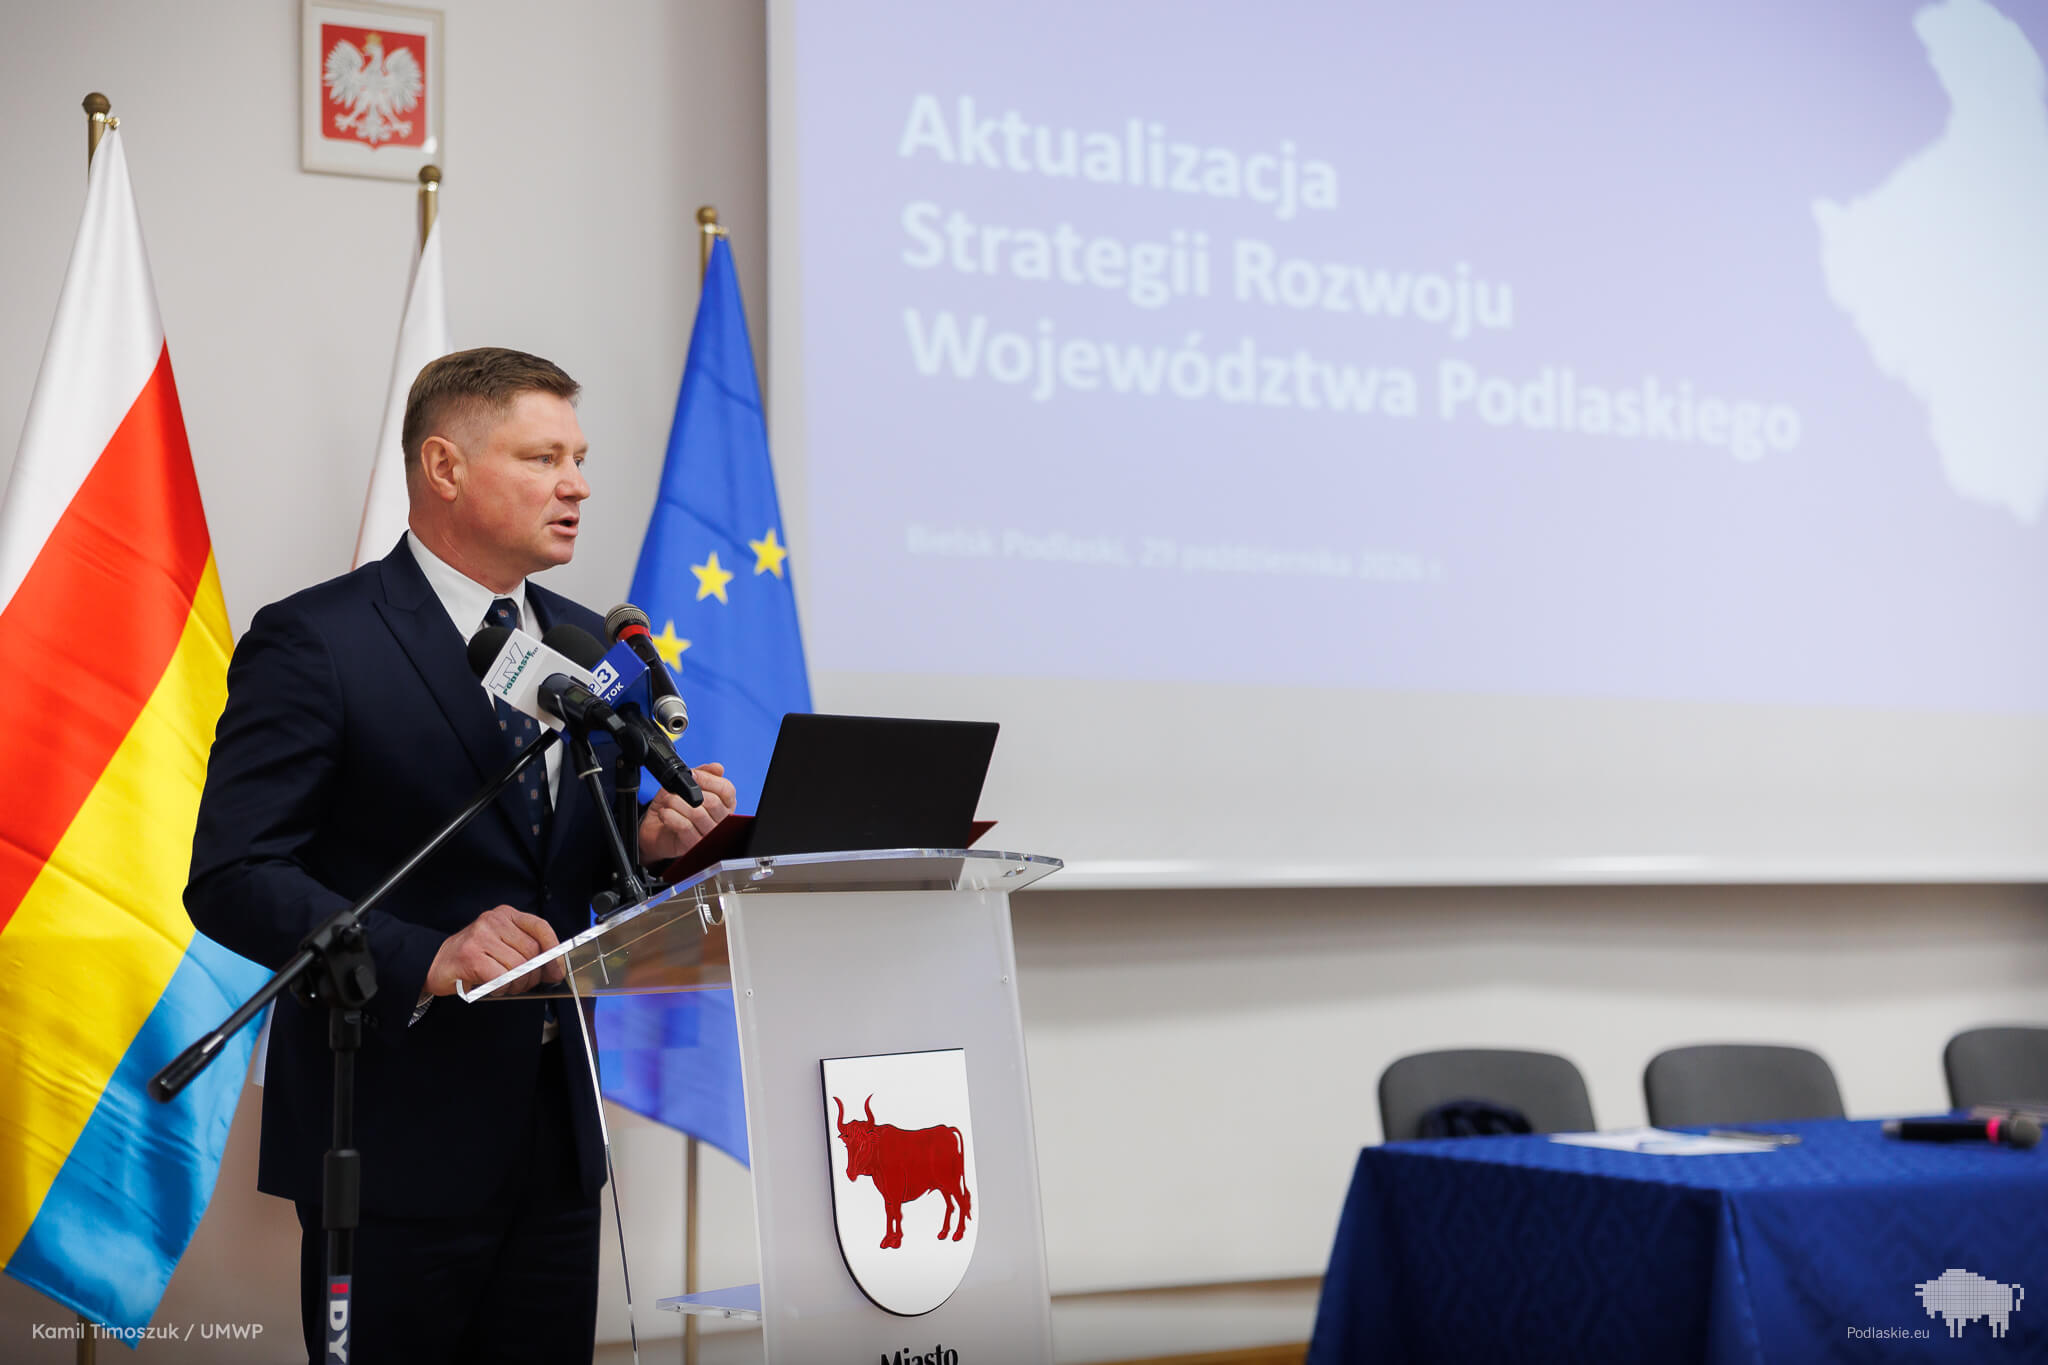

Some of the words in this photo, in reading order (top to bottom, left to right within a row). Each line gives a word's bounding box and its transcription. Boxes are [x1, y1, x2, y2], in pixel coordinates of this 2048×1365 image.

[897, 92, 1339, 221] Aktualizacja
[901, 200, 1210, 308] Strategii
[1233, 239, 1513, 340] Rozwoju
[902, 307, 1418, 418] Województwa
[1437, 357, 1802, 463] Podlaskiego
[603, 681, 625, 702] TOK
[328, 1300, 349, 1365] DY
